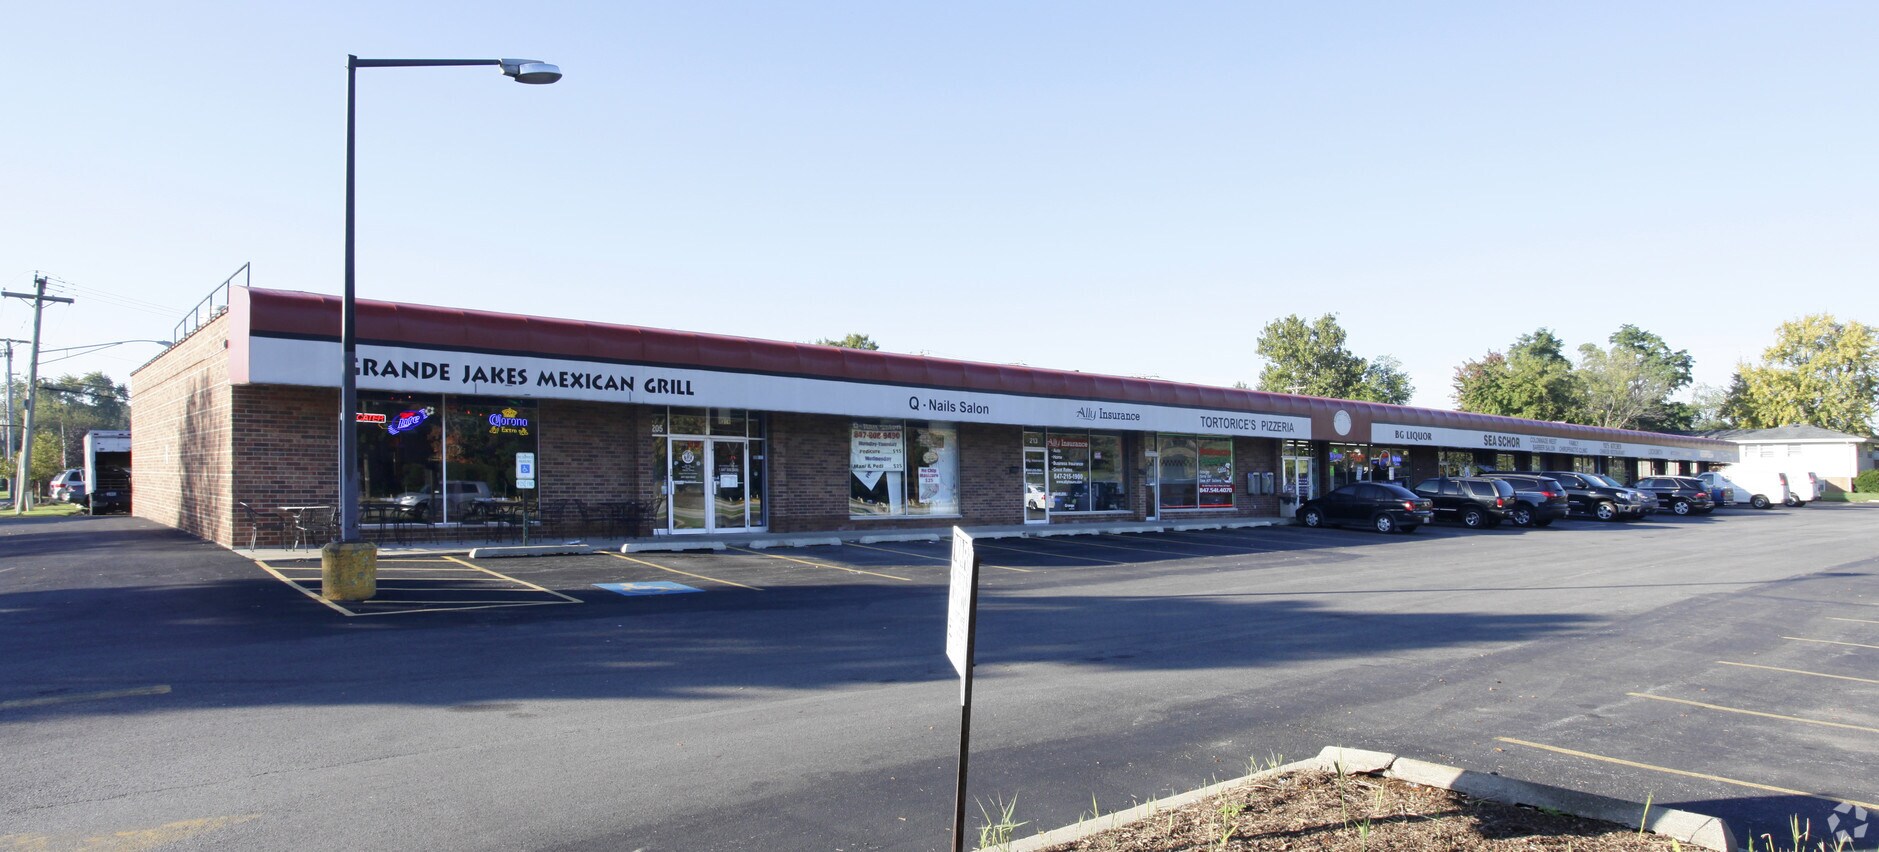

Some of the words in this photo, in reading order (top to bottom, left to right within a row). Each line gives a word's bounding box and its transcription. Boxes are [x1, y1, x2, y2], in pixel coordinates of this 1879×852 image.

[462, 364, 528, 385] JAKES
[536, 370, 634, 392] MEXICAN
[644, 378, 694, 396] GRILL
[909, 396, 919, 411] Q
[929, 399, 956, 412] Nails
[959, 401, 989, 414] Salon
[489, 413, 528, 427] Corona
[1076, 407, 1096, 421] Ally
[1099, 408, 1140, 421] Insurance
[651, 424, 664, 433] 205
[1200, 416, 1257, 431] TORTORICE'S
[1261, 420, 1295, 433] PIZZERIA
[1394, 430, 1404, 439] BG
[1406, 431, 1432, 441] LIQUOR
[1483, 435, 1497, 446] SEA
[1498, 437, 1520, 448] SCHOR
[1061, 439, 1088, 448] Insurance
